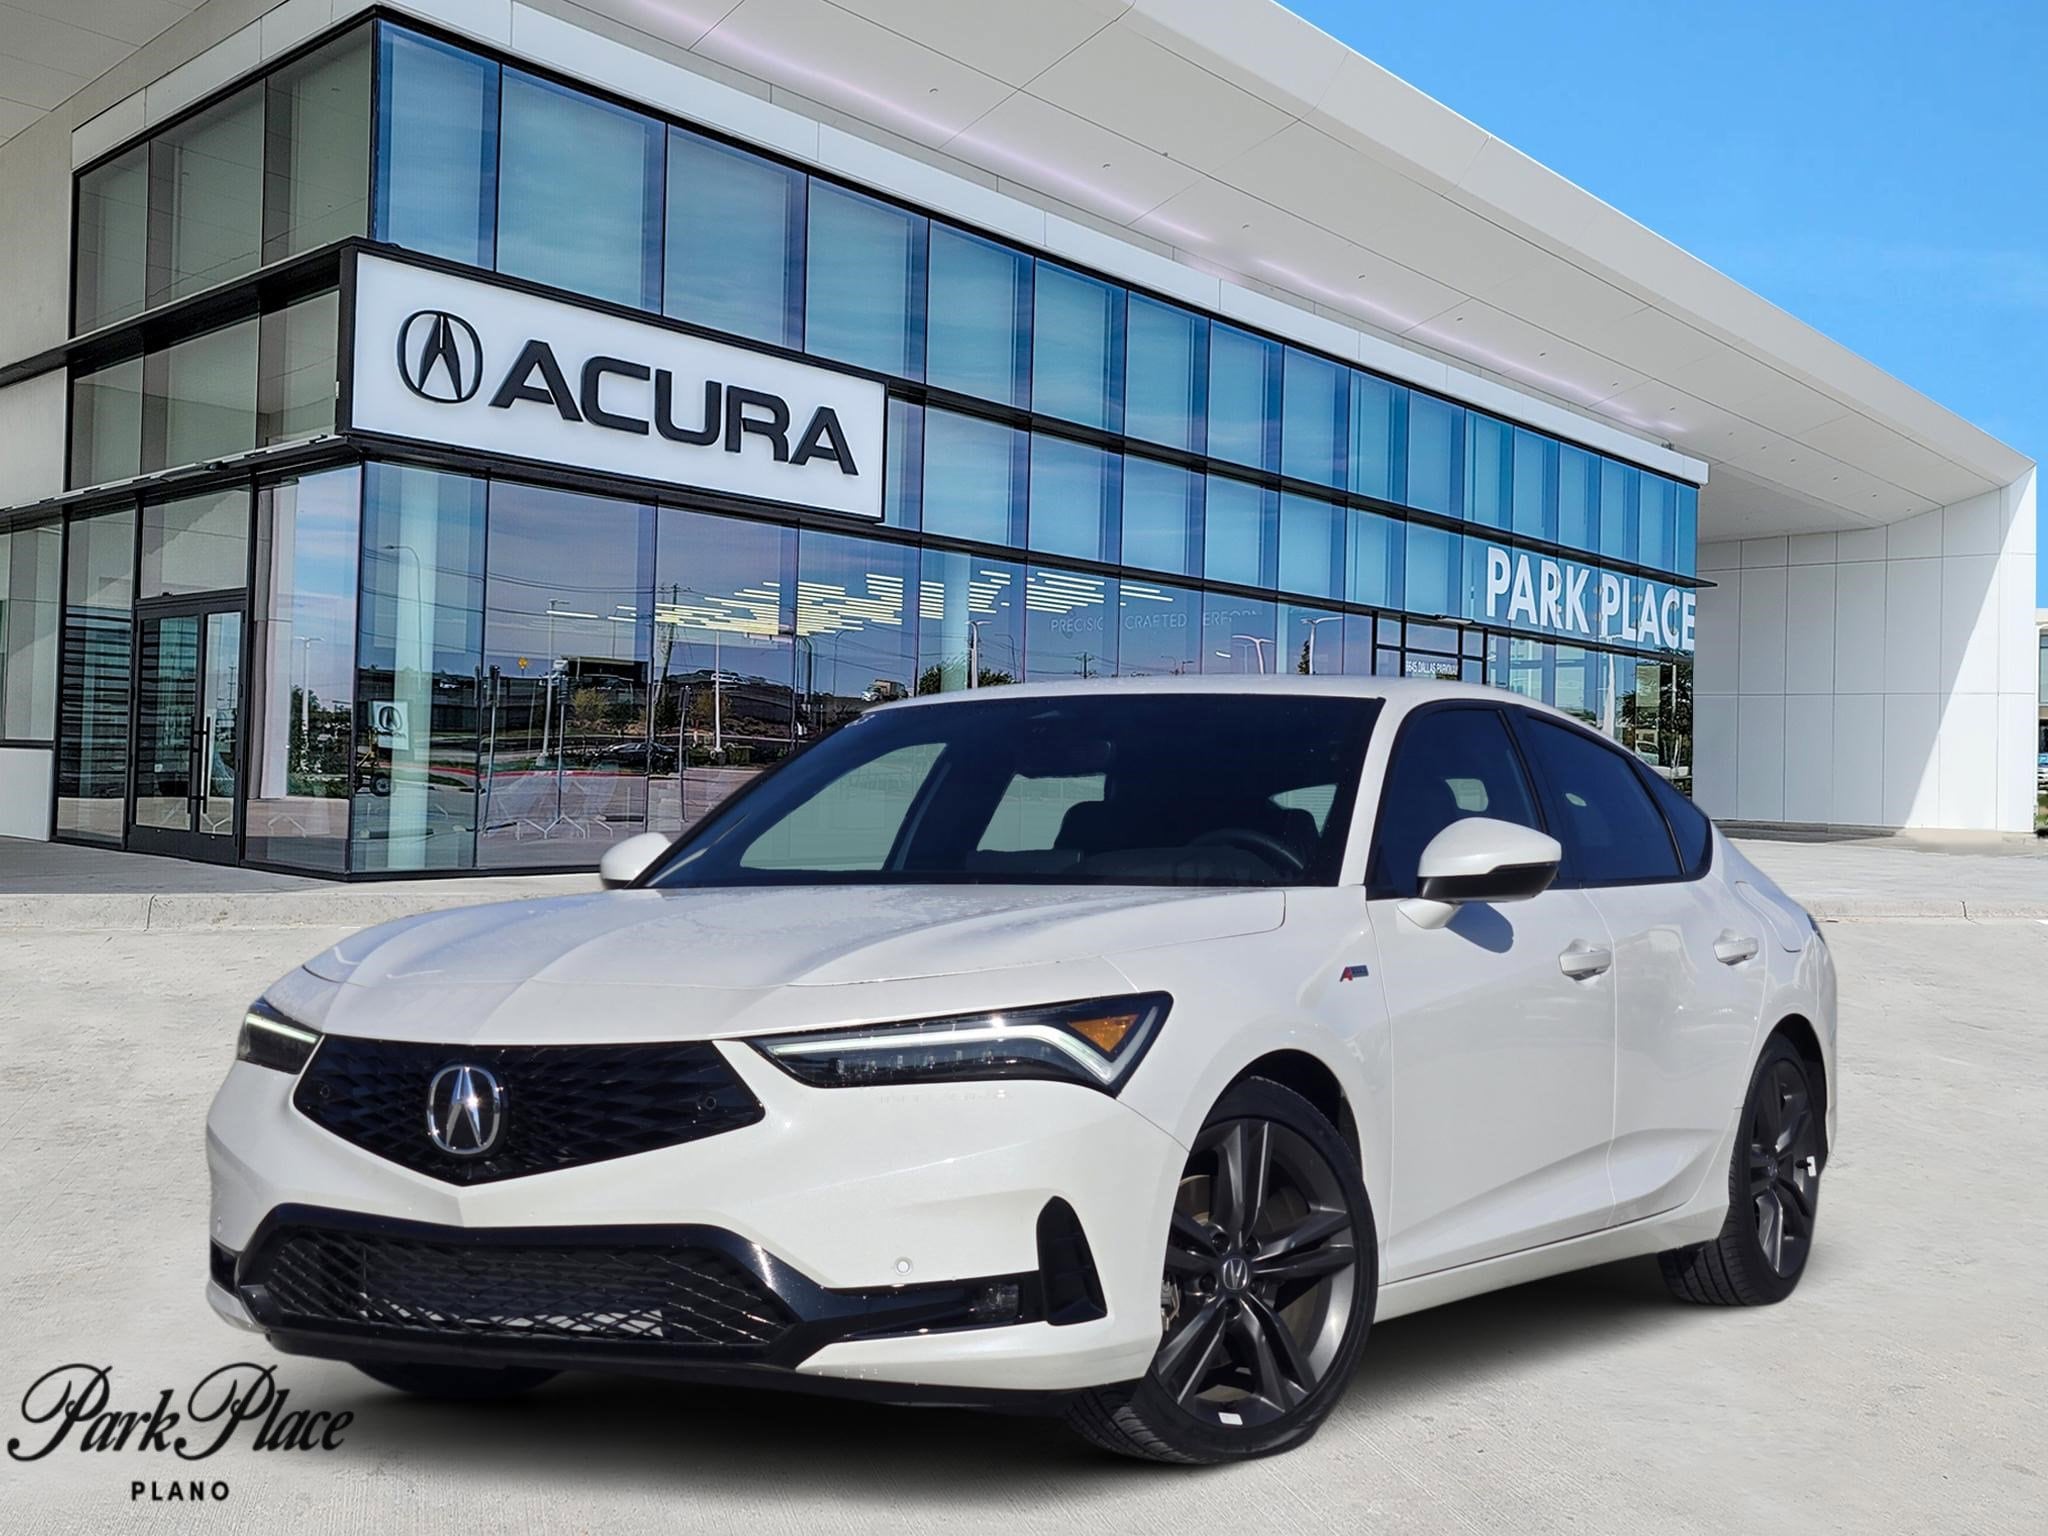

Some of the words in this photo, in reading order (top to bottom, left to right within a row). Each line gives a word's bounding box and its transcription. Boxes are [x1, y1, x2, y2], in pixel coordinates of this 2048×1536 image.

[488, 338, 860, 476] ACURA
[1124, 613, 1188, 630] CRAFTED
[1486, 546, 1591, 634] PARK
[1600, 573, 1696, 651] PLACE
